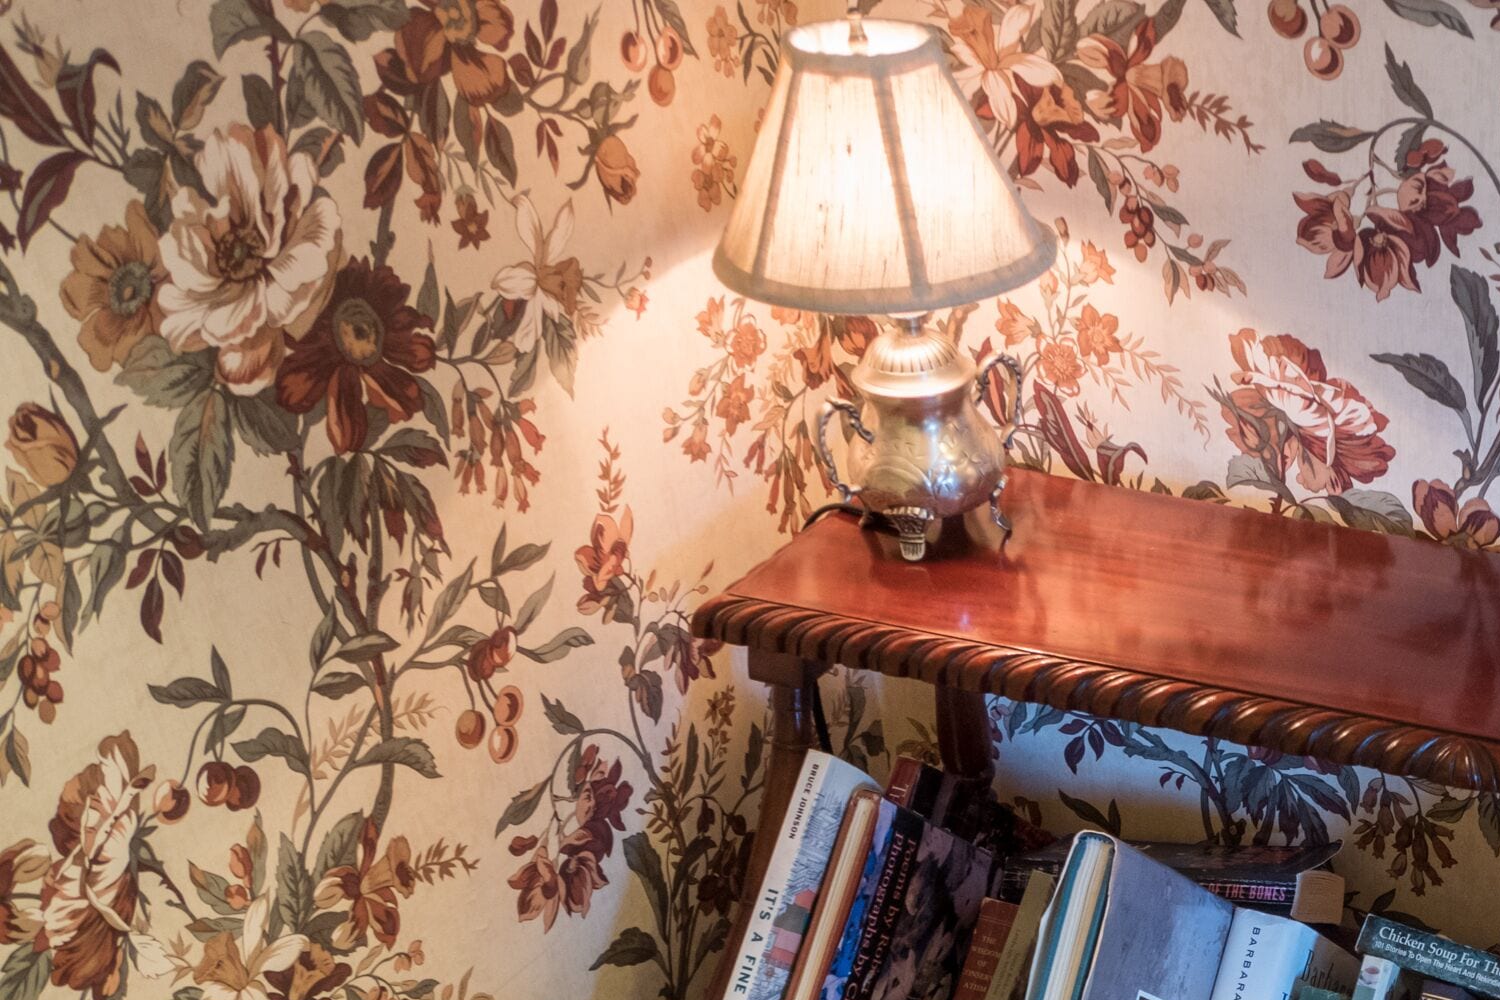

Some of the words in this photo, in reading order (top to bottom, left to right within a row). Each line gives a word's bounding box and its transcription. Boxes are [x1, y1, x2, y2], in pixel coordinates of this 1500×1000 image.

[803, 763, 820, 796] BRUCE
[789, 798, 807, 840] JOHNSON
[896, 840, 916, 904] Poems
[759, 888, 779, 920] IT'S
[861, 834, 904, 956] Photographs
[1225, 884, 1246, 899] THE
[1249, 885, 1287, 901] BONES
[884, 905, 899, 926] by
[751, 932, 763, 943] A
[1379, 926, 1426, 951] Chicken
[1427, 942, 1458, 962] Soup
[1459, 952, 1480, 969] For
[734, 954, 757, 994] FINE
[853, 957, 867, 978] by
[1374, 940, 1385, 949] 101
[1385, 943, 1406, 957] Stories
[1415, 953, 1432, 966] Open
[1433, 958, 1444, 969] The
[1445, 962, 1462, 976] Heart
[1462, 969, 1475, 980] And
